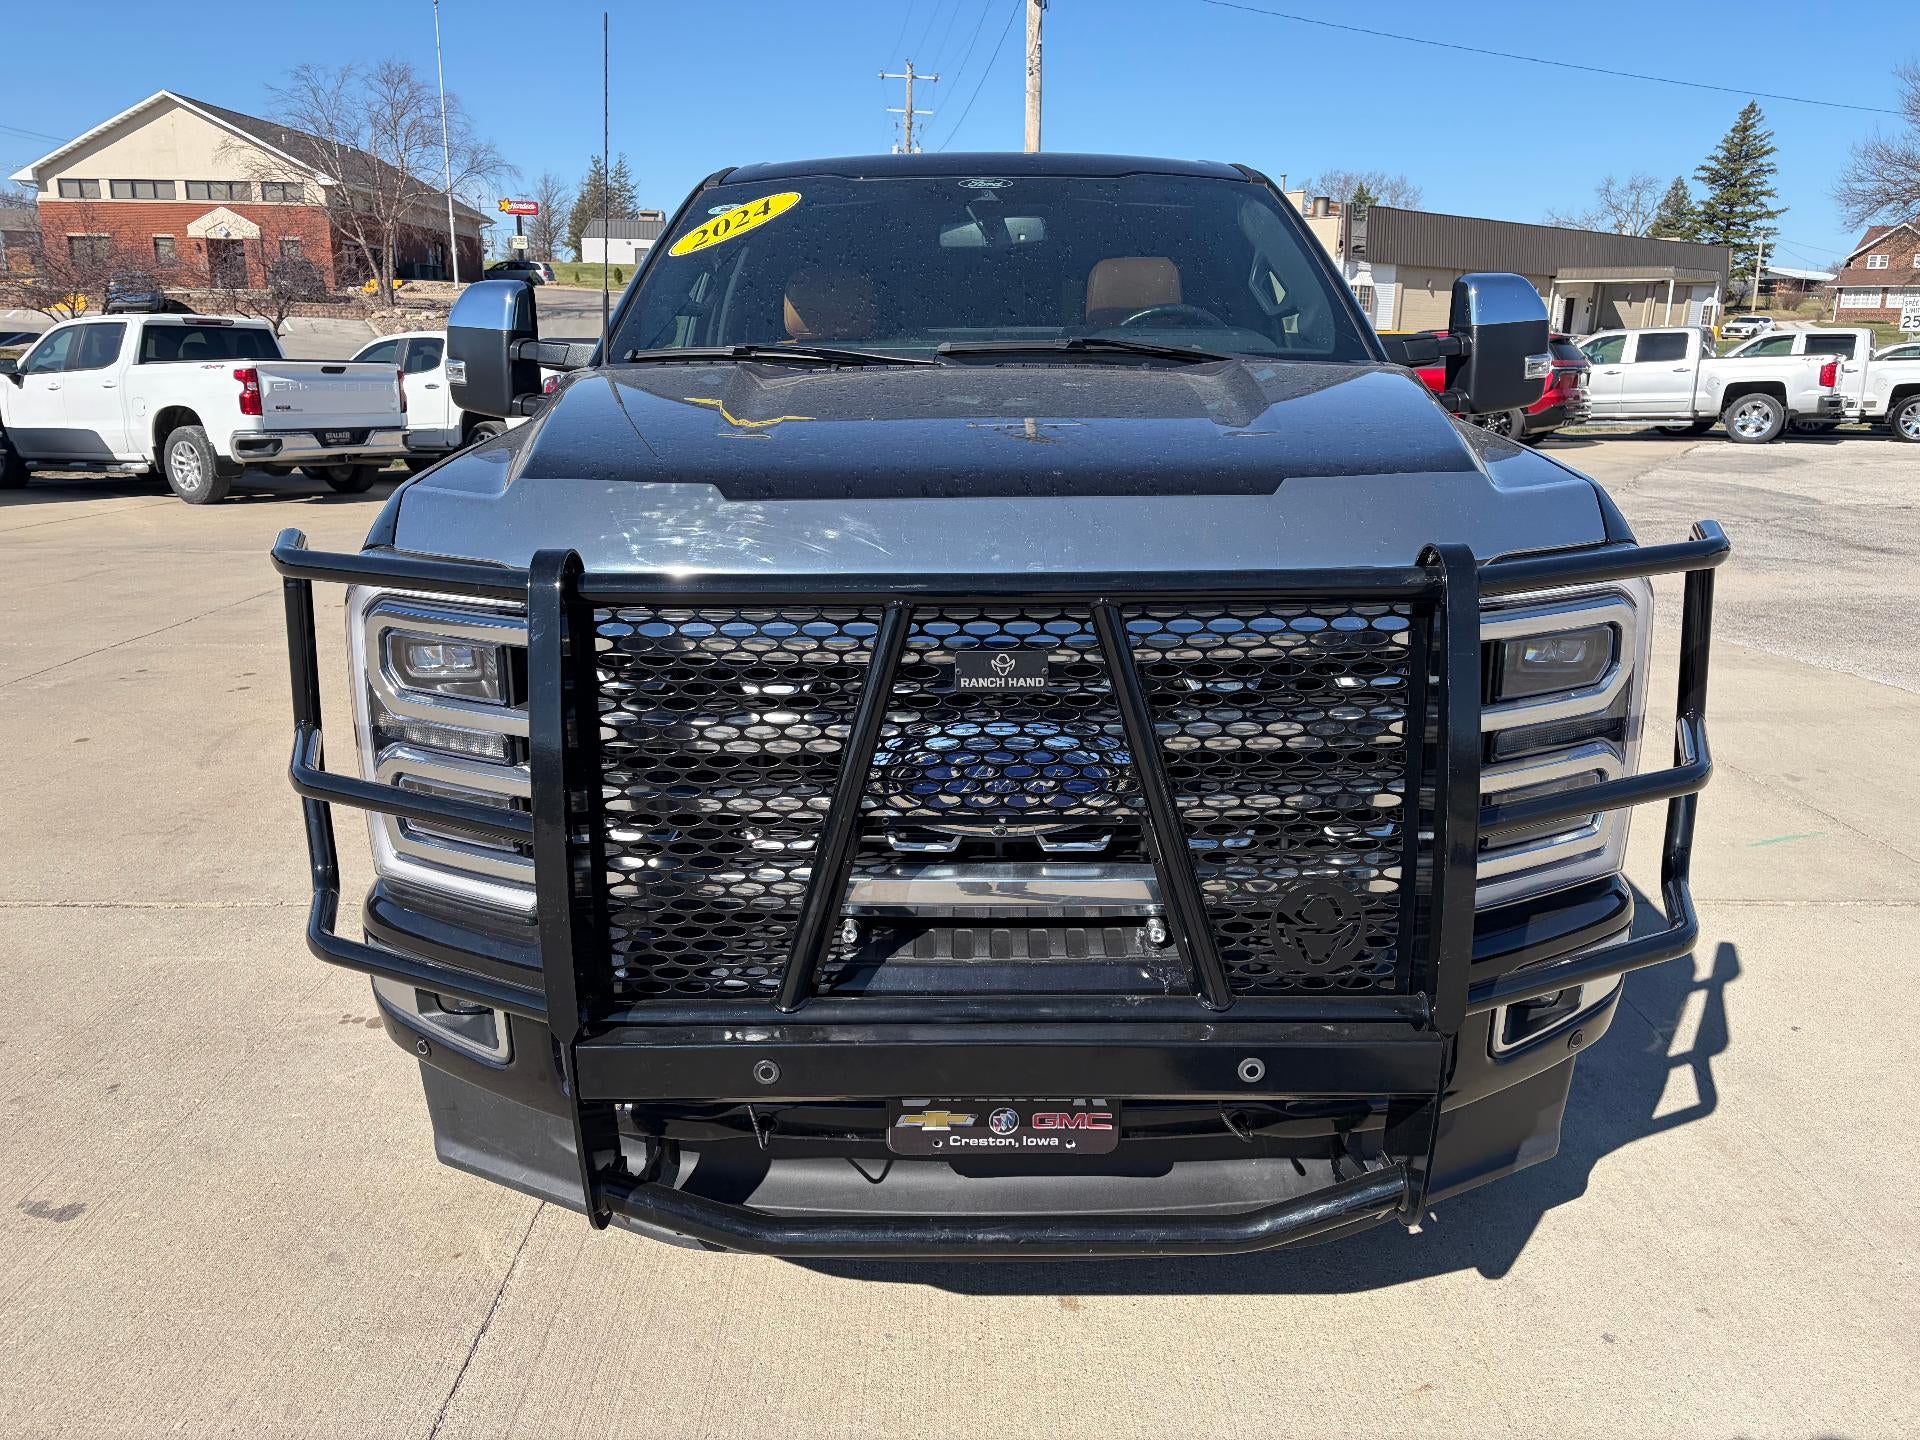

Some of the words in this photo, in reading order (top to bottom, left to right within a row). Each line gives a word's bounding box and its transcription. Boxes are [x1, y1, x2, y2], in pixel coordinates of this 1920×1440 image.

[968, 180, 1003, 188] Ford
[692, 199, 771, 248] 2024
[1902, 315, 1920, 328] 25
[960, 677, 1005, 688] RANCH
[1008, 677, 1044, 688] HAND
[1032, 1112, 1112, 1130] GMC
[949, 1135, 1019, 1147] Creston,
[1022, 1135, 1059, 1146] Iowa
